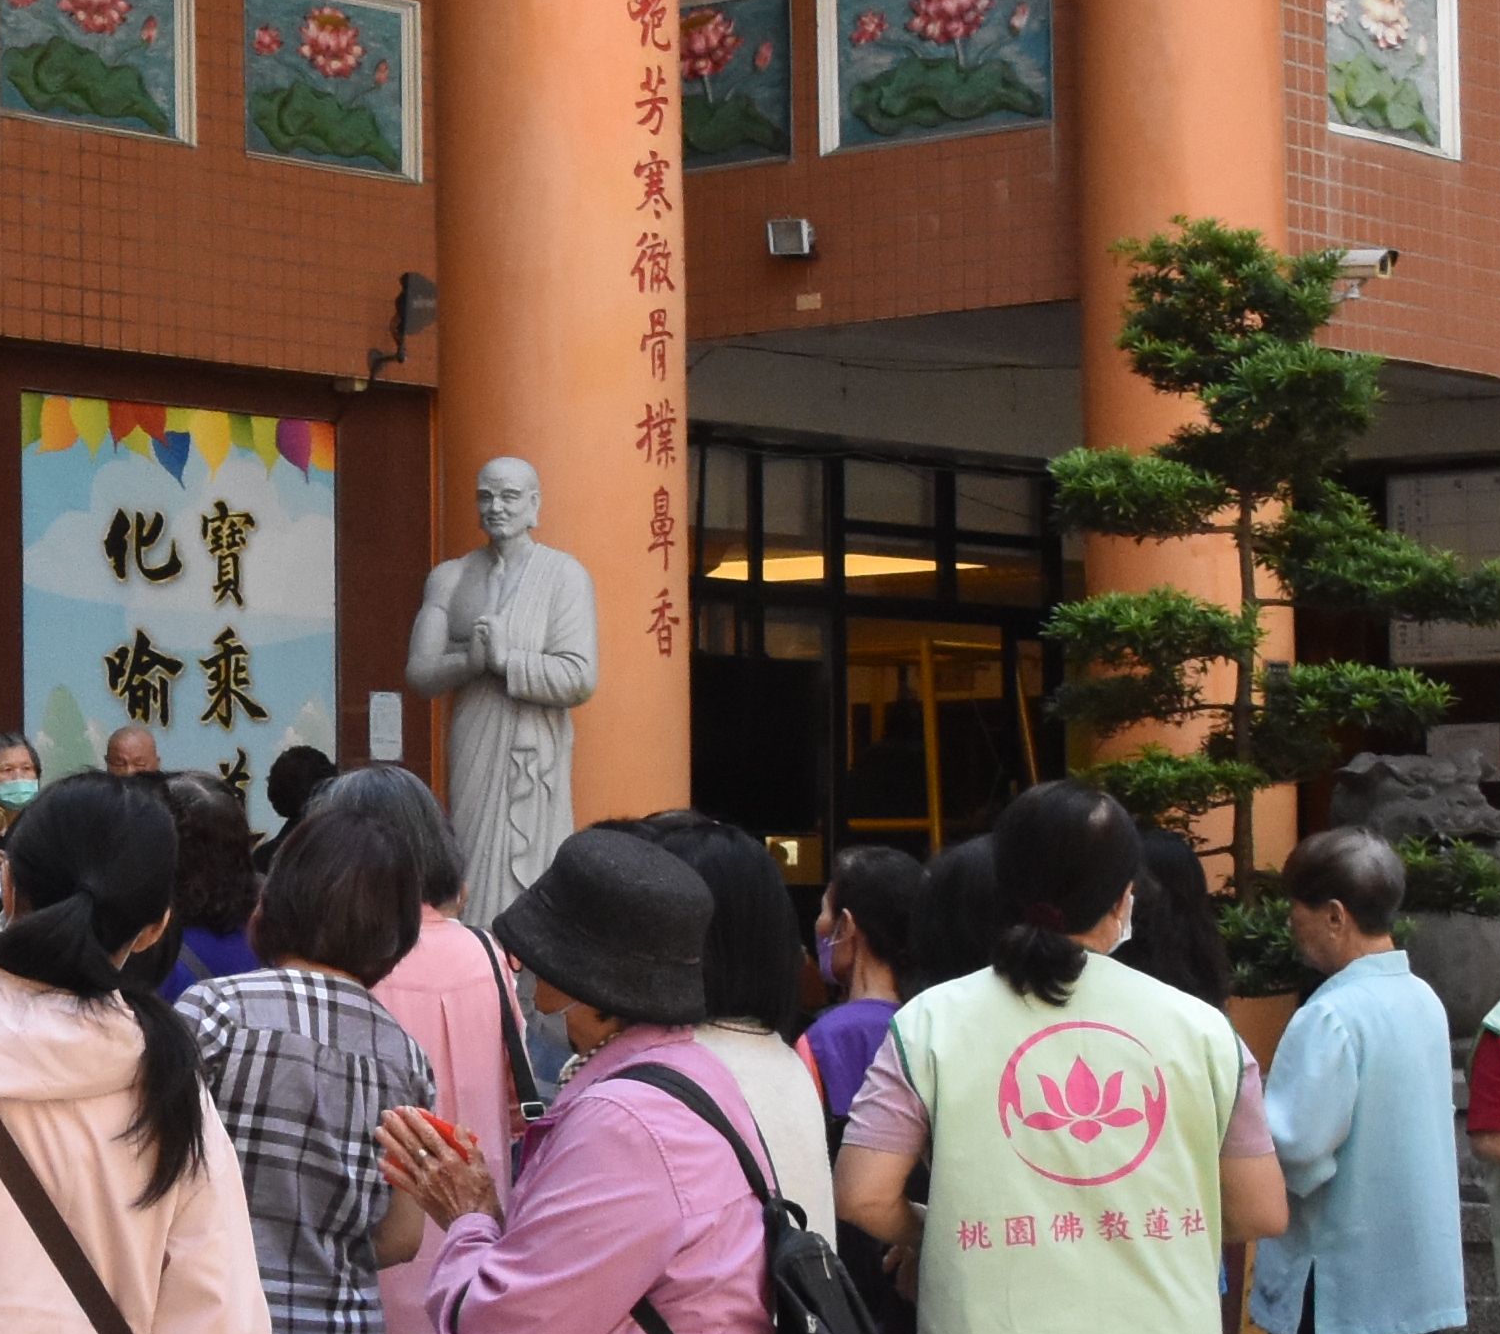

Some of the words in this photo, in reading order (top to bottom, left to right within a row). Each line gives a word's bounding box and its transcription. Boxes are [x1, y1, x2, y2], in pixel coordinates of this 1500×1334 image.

[104, 507, 184, 728] 化喻
[200, 500, 269, 849] 寶乘
[956, 1207, 1207, 1252] 桃園佛教蓮社
